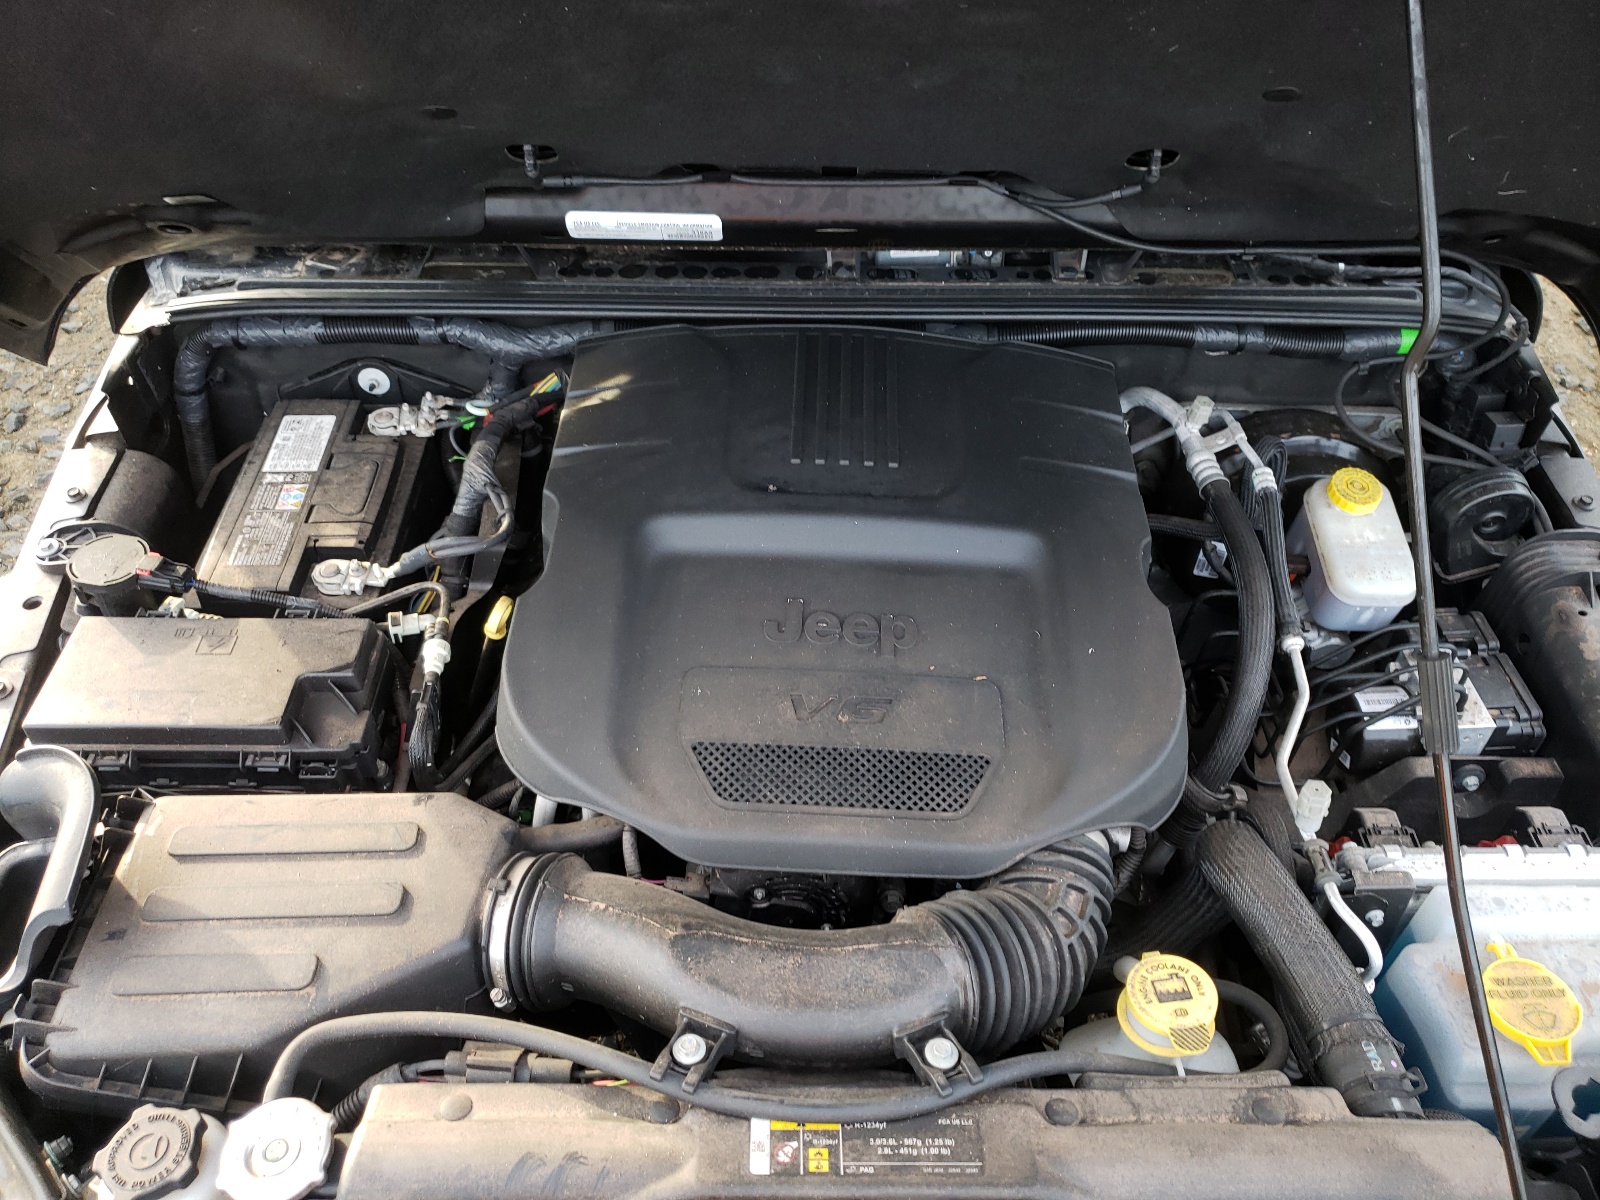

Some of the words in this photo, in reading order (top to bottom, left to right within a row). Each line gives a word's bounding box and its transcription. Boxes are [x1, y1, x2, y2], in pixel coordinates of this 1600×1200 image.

[762, 597, 918, 658] Jeep
[789, 693, 893, 724] V6
[1146, 962, 1190, 975] COOLANT
[1490, 975, 1553, 987] WASHER
[1487, 989, 1528, 1000] FLUID
[1530, 988, 1566, 999] ONLY
[859, 1166, 874, 1174] PAG
